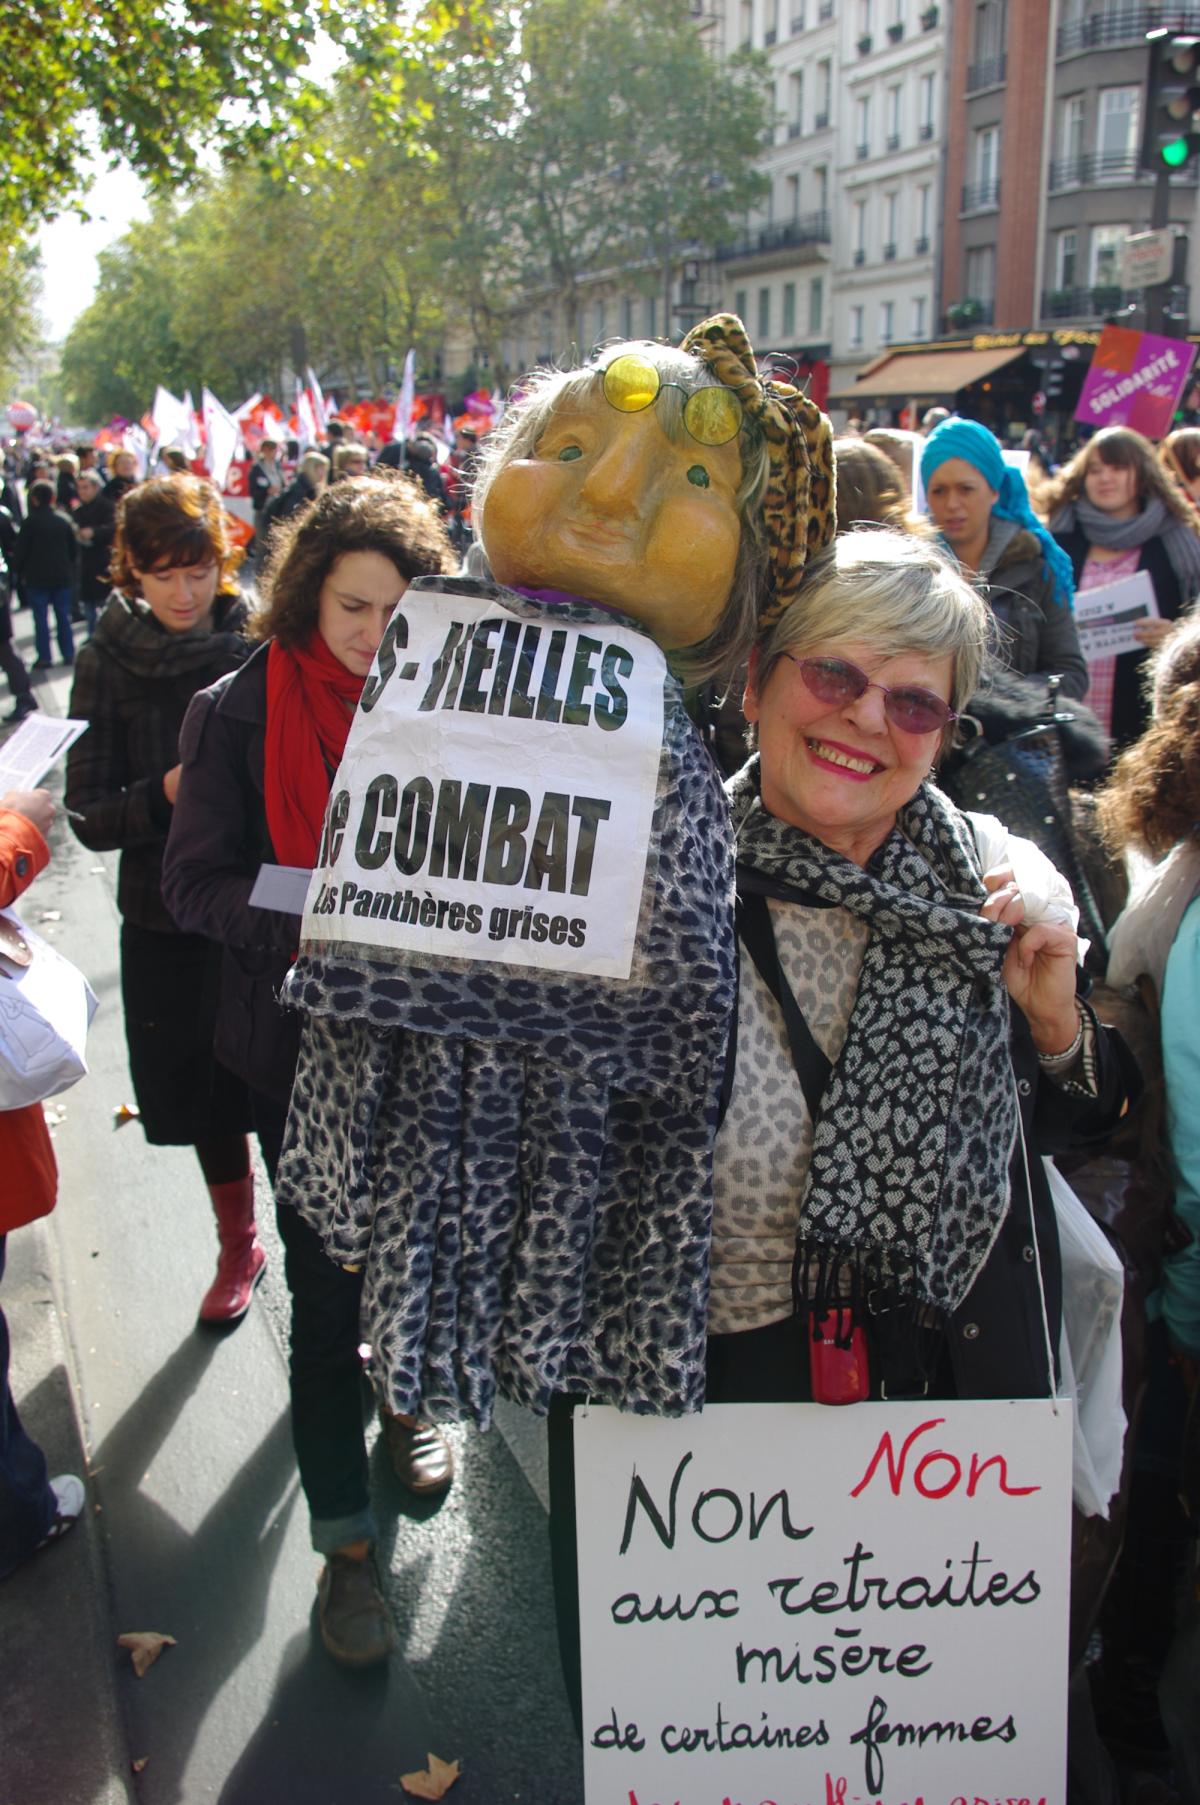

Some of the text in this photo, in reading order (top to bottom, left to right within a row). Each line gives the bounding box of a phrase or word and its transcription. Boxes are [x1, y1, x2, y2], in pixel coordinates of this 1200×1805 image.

[354, 773, 612, 898] COMBAT
[339, 881, 484, 935] Panthères
[488, 905, 587, 948] grises
[620, 1418, 1041, 1555] Non Non
[611, 1538, 1041, 1625] aux retraites
[591, 1707, 646, 1753] de
[661, 1702, 830, 1754] certaines
[850, 1695, 1017, 1796] femmes
